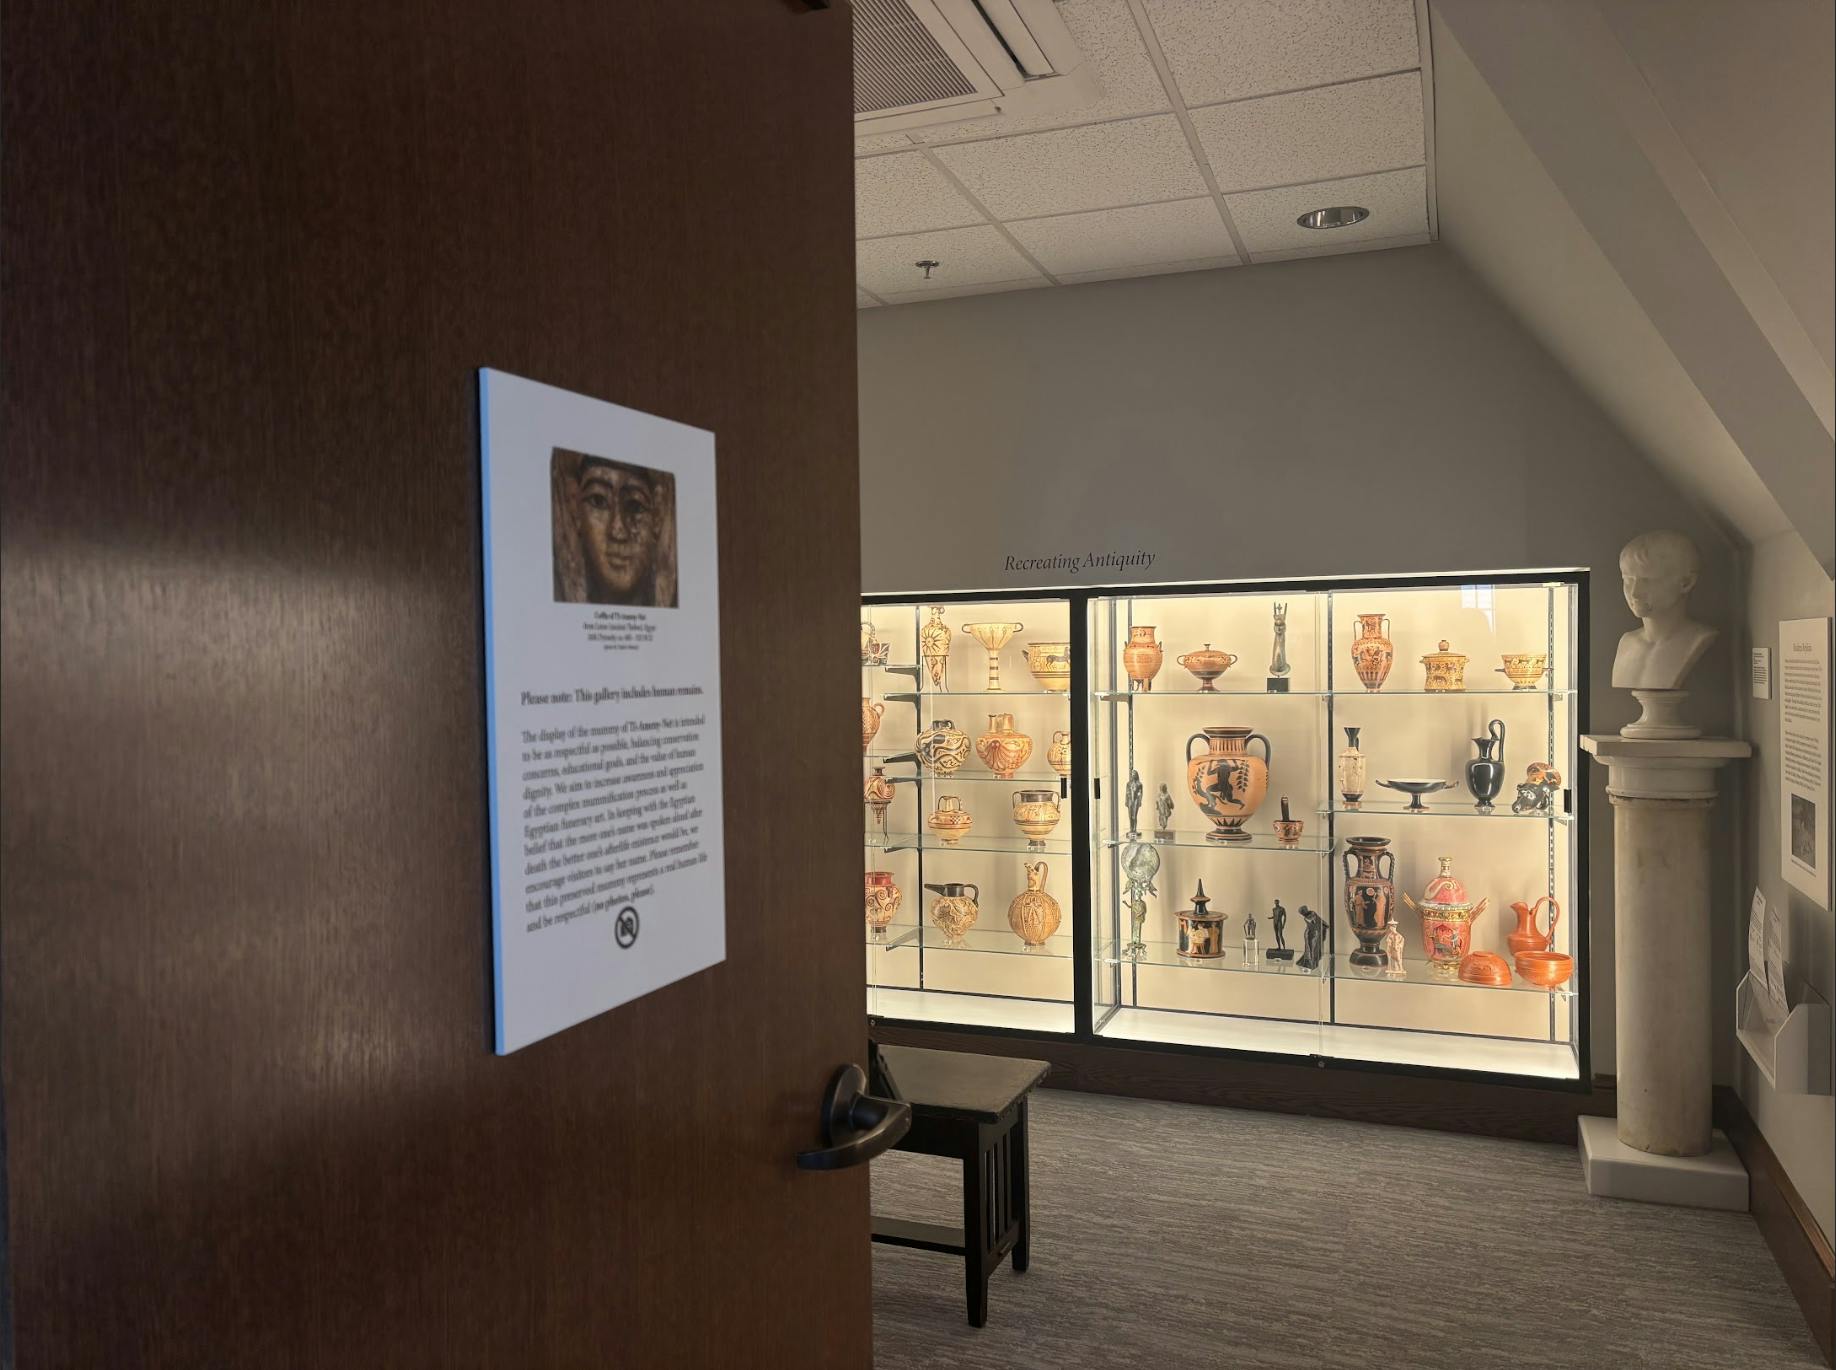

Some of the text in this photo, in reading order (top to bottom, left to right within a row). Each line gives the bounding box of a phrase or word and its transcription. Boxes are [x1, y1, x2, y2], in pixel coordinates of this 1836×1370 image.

[1005, 550, 1156, 574] Recreating Antiquity
[521, 693, 550, 705] Please
[551, 692, 572, 703] note:
[575, 690, 592, 702] This
[594, 689, 619, 703] gallery
[621, 687, 650, 699] includes
[651, 686, 675, 697] human
[522, 731, 537, 744] The
[539, 729, 565, 744] display
[567, 727, 576, 739] of
[578, 726, 588, 738] the
[622, 722, 629, 733] of
[522, 751, 530, 762] to
[532, 749, 543, 761] be
[545, 750, 552, 759] as
[554, 743, 590, 760] respectful
[592, 745, 599, 753] as
[630, 736, 661, 749] balancing
[561, 759, 603, 776] educational
[626, 754, 638, 766] and
[639, 753, 649, 764] the
[651, 751, 666, 762] value
[668, 749, 674, 760] of
[676, 749, 696, 759] human
[523, 786, 552, 802] dignity.
[555, 782, 567, 795] We
[569, 781, 582, 792] aim
[584, 779, 591, 790] to
[657, 766, 667, 778] and
[524, 806, 532, 819] of
[533, 804, 546, 817] the
[548, 799, 580, 814] complex
[582, 790, 633, 808] mummification
[660, 785, 666, 794] as
[668, 780, 679, 792] well
[681, 782, 687, 790] as
[524, 822, 558, 840] Egyptian
[560, 816, 593, 831] funerary
[608, 810, 614, 821] In
[616, 806, 642, 820] keeping
[643, 801, 657, 814] with
[658, 799, 668, 810] the
[669, 795, 695, 810] Egyptian
[524, 841, 546, 857] belief
[548, 838, 562, 851] that
[565, 835, 576, 848] the
[579, 833, 597, 844] more
[617, 824, 634, 836] name
[637, 822, 647, 832] was
[649, 816, 671, 831] spoken
[689, 809, 702, 820] after
[525, 859, 547, 876] death
[549, 857, 561, 870] the
[563, 853, 584, 866] better
[661, 828, 679, 842] would
[690, 826, 698, 835] we
[525, 876, 565, 894] encourage
[567, 869, 593, 883] visitors
[594, 866, 601, 876] to
[616, 859, 627, 870] her
[649, 850, 668, 862] Please
[525, 898, 541, 913] that
[543, 895, 558, 908] this
[559, 883, 595, 907] preserved
[676, 858, 697, 871] human
[526, 917, 542, 933] and
[543, 915, 553, 927] be
[555, 902, 590, 924] respectful
[592, 901, 603, 916] (no
[605, 894, 629, 912] photos,
